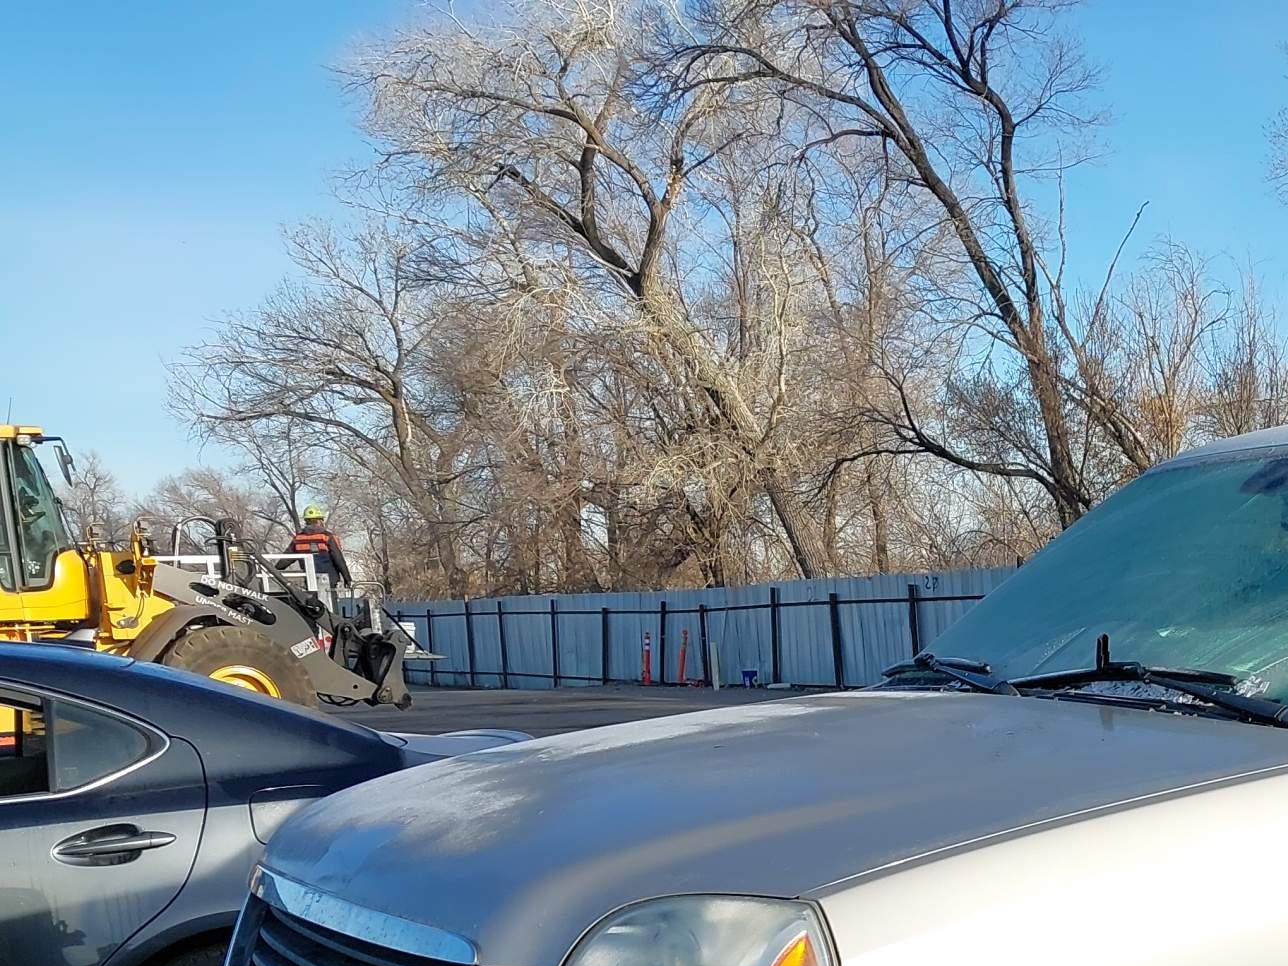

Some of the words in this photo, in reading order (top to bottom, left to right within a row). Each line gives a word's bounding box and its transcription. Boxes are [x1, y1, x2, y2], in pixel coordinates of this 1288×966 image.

[200, 575, 216, 587] DO
[218, 580, 239, 593] NOT
[240, 587, 269, 602] WALK
[228, 610, 253, 625] MAST
